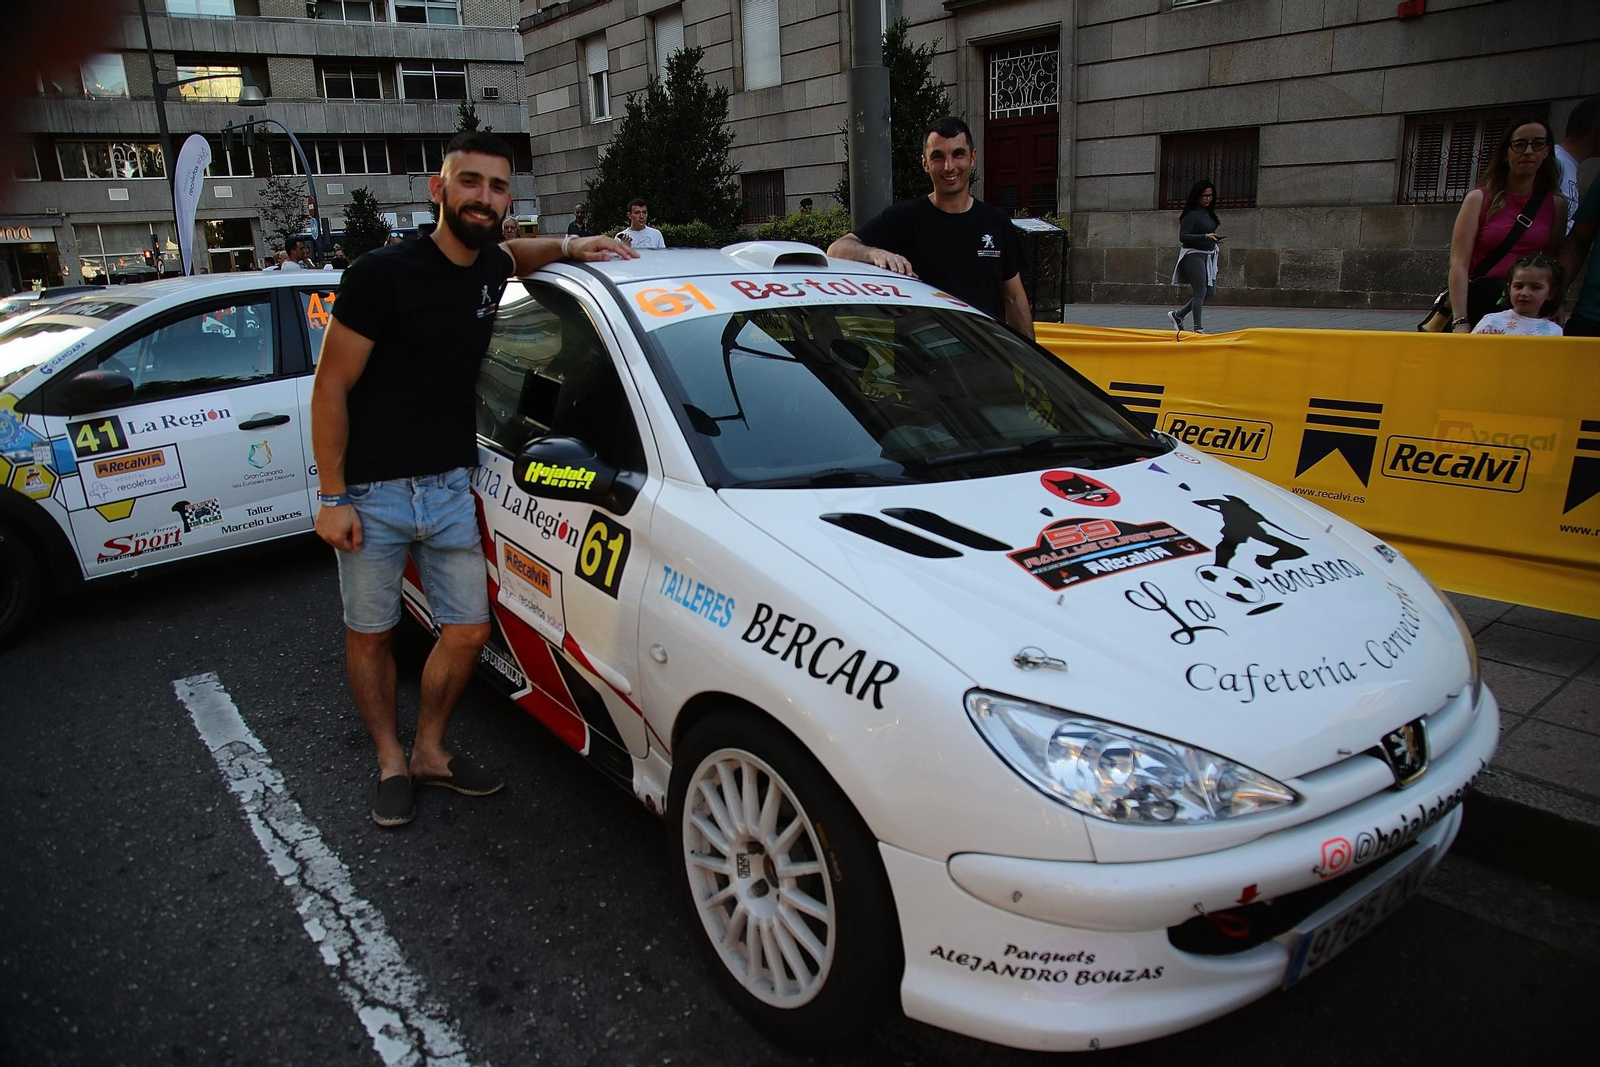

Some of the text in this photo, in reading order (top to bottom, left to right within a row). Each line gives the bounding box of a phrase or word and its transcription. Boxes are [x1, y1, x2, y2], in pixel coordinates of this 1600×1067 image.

[0, 225, 32, 241] na
[635, 282, 717, 318] 61
[75, 420, 121, 453] 41
[127, 421, 158, 436] La
[1169, 419, 1266, 453] Recalvi
[110, 455, 150, 472] Recalvi
[524, 461, 597, 484] Hojalata
[1389, 443, 1522, 484] Recalvi
[117, 471, 180, 491] recoletas salud
[1291, 486, 1366, 504] www.recalvi.es
[246, 505, 274, 516] Taller
[501, 485, 522, 516] La
[221, 519, 264, 534] Marcelo
[266, 510, 302, 524] Luaces
[1043, 520, 1121, 550] 59
[97, 527, 182, 563] Sport
[580, 521, 624, 589] 61
[1103, 547, 1158, 571] Recalvi
[513, 554, 540, 587] Recalvi
[660, 565, 735, 628] TALLERES
[1125, 581, 1228, 645] La
[741, 603, 899, 710] BERCAR
[1003, 944, 1096, 964] Parquets
